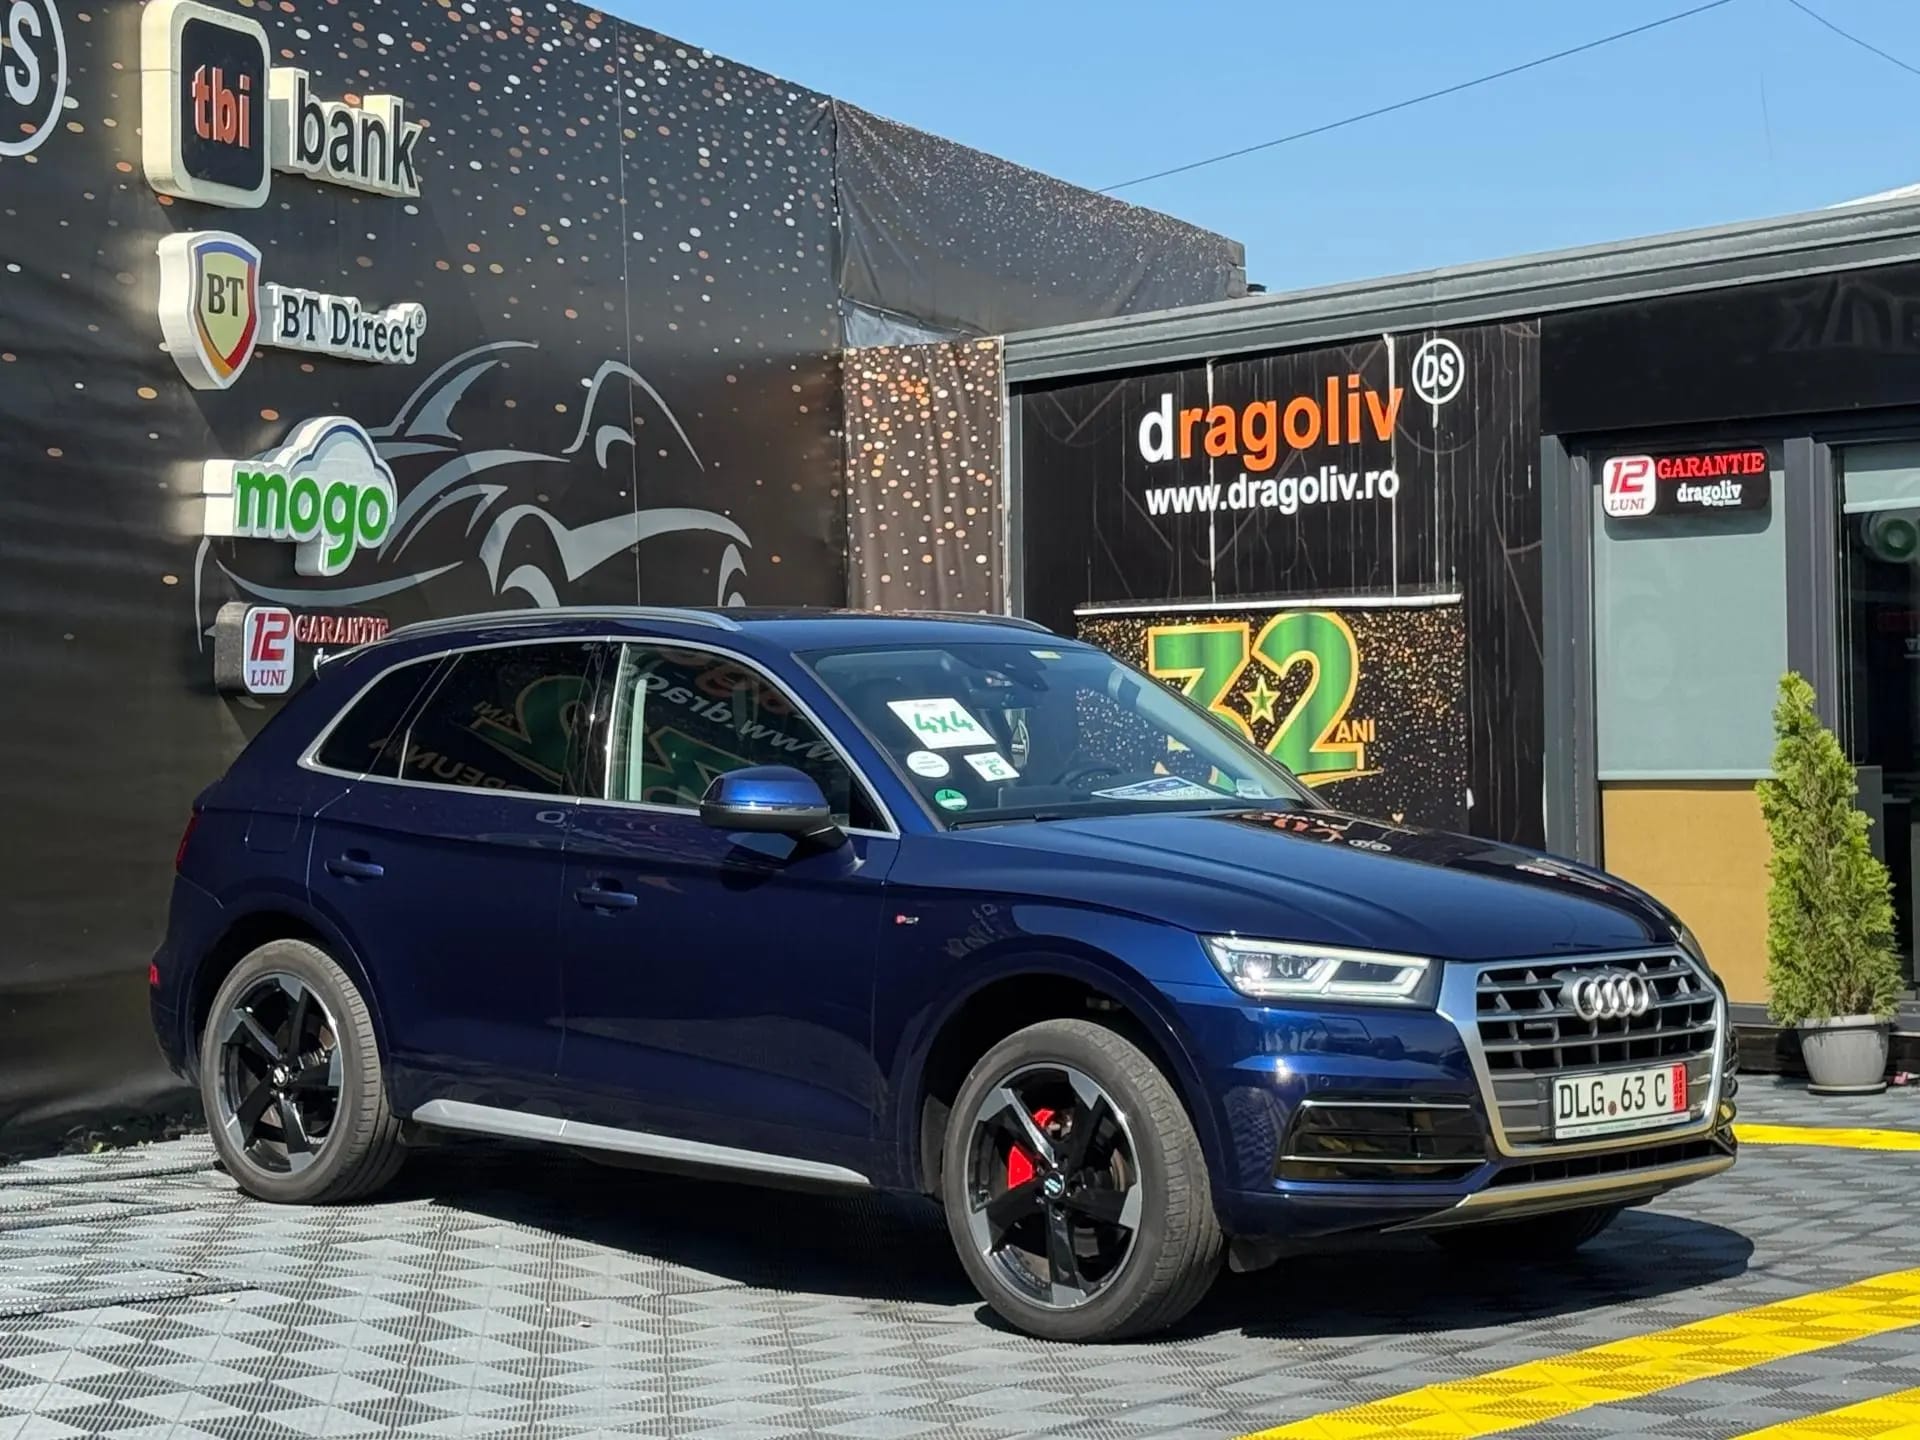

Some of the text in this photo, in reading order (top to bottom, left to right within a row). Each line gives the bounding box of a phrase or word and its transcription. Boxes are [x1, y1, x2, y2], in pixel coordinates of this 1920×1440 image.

[0, 1, 41, 106] S
[191, 64, 419, 190] tbi bank
[206, 273, 244, 317] BT
[281, 294, 320, 342] BT
[1421, 352, 1455, 389] DS
[1138, 373, 1404, 472] dragoliv
[1610, 459, 1649, 494] 12
[1657, 451, 1765, 480] GARANTIE
[1145, 465, 1400, 516] www.dragoliv.ro
[1610, 497, 1646, 511] LUNI
[1676, 480, 1742, 506] dragoliv
[235, 470, 389, 568] mogo
[250, 612, 291, 661] 12
[295, 614, 390, 645] GARANTIE
[251, 669, 287, 687] LUNI
[1335, 718, 1376, 744] ANI
[1559, 1081, 1605, 1119] DLG
[1621, 1076, 1646, 1112] 63
[1655, 1072, 1667, 1107] C
